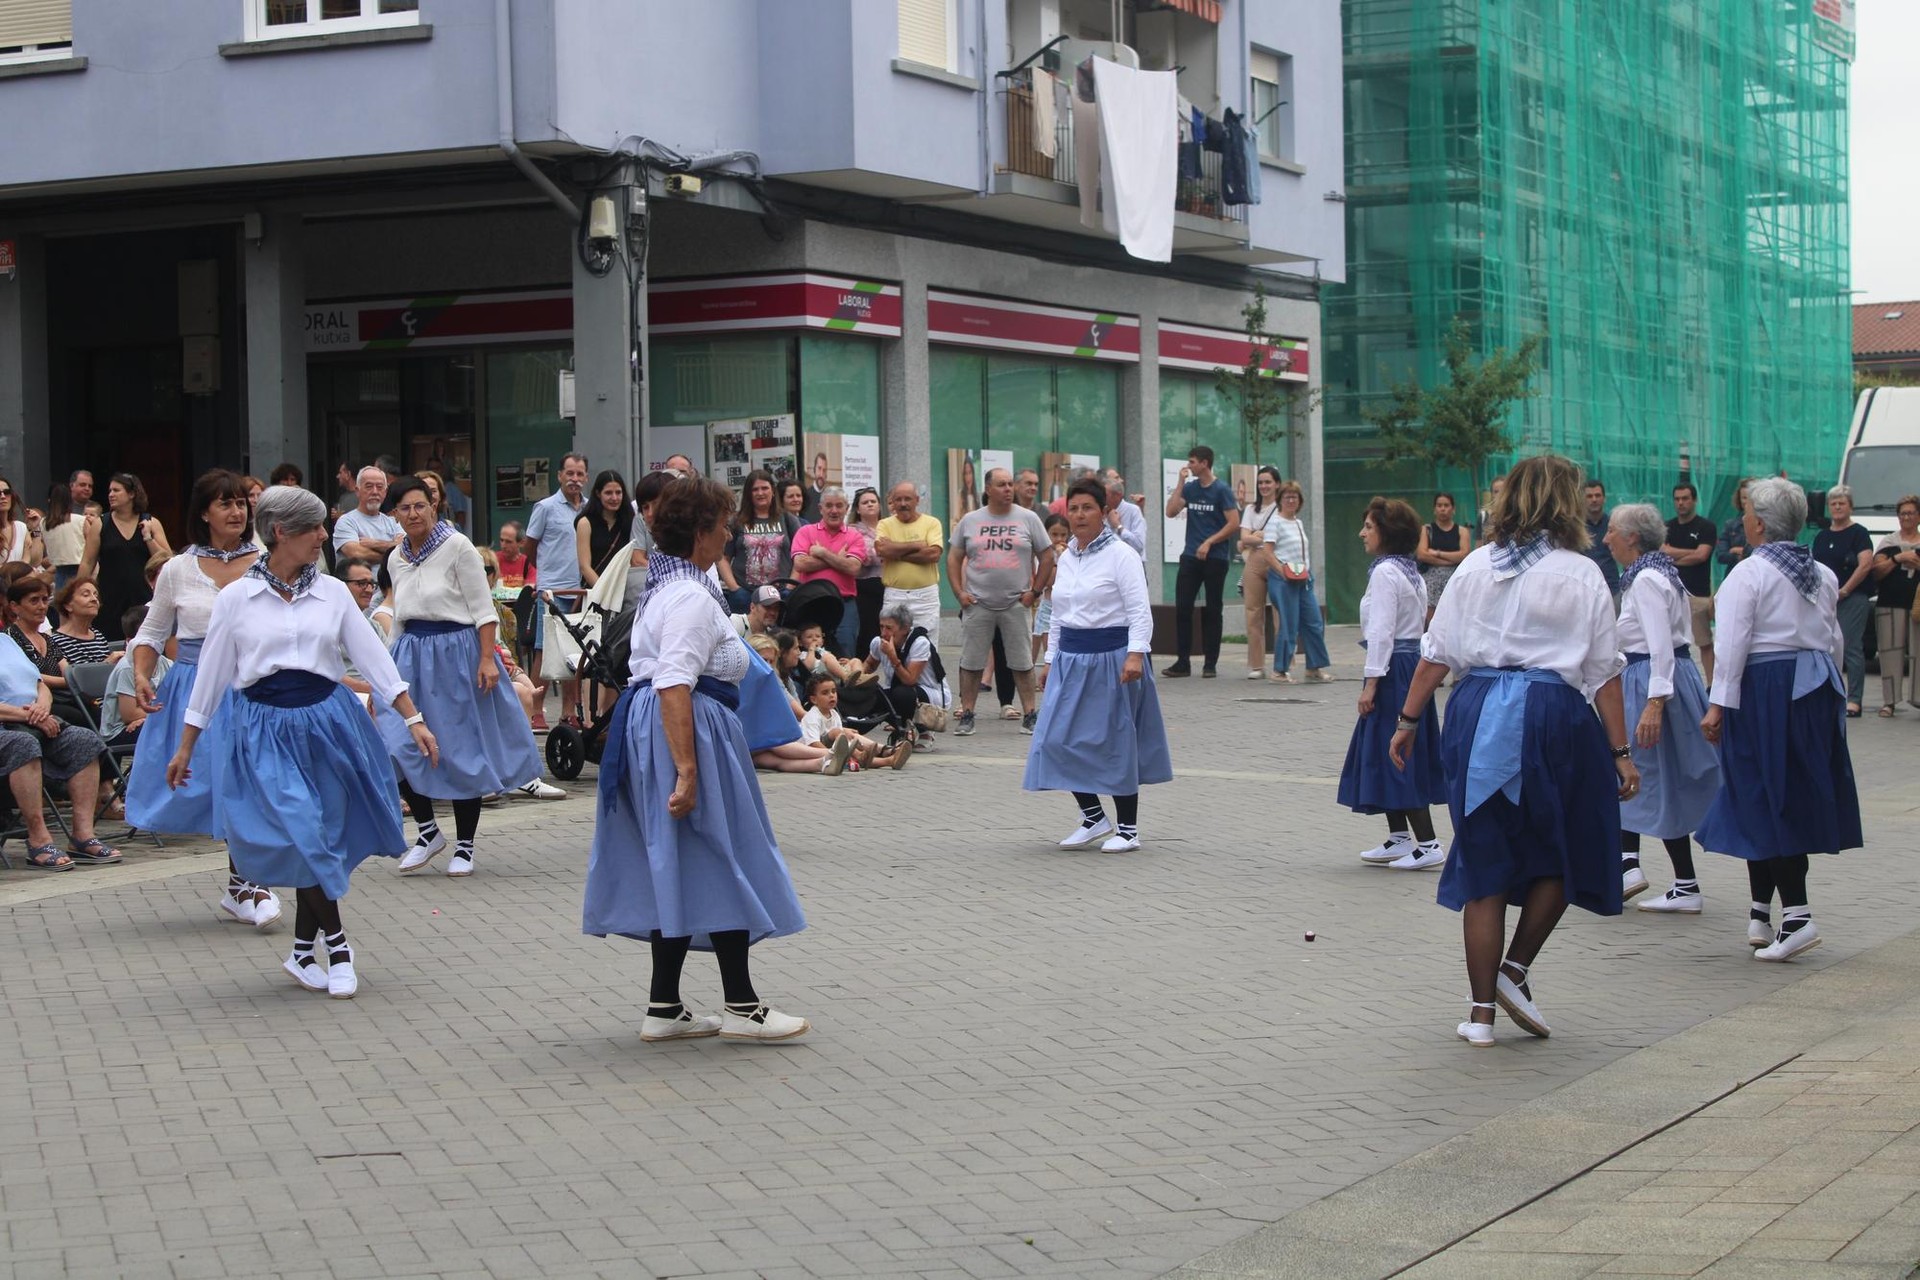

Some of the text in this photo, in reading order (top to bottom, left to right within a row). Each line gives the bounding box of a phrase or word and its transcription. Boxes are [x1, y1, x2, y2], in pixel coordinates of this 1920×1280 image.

[838, 293, 872, 309] LABORAL
[313, 331, 351, 345] kutxa
[980, 525, 1017, 537] PEPE
[984, 538, 1013, 551] JNS
